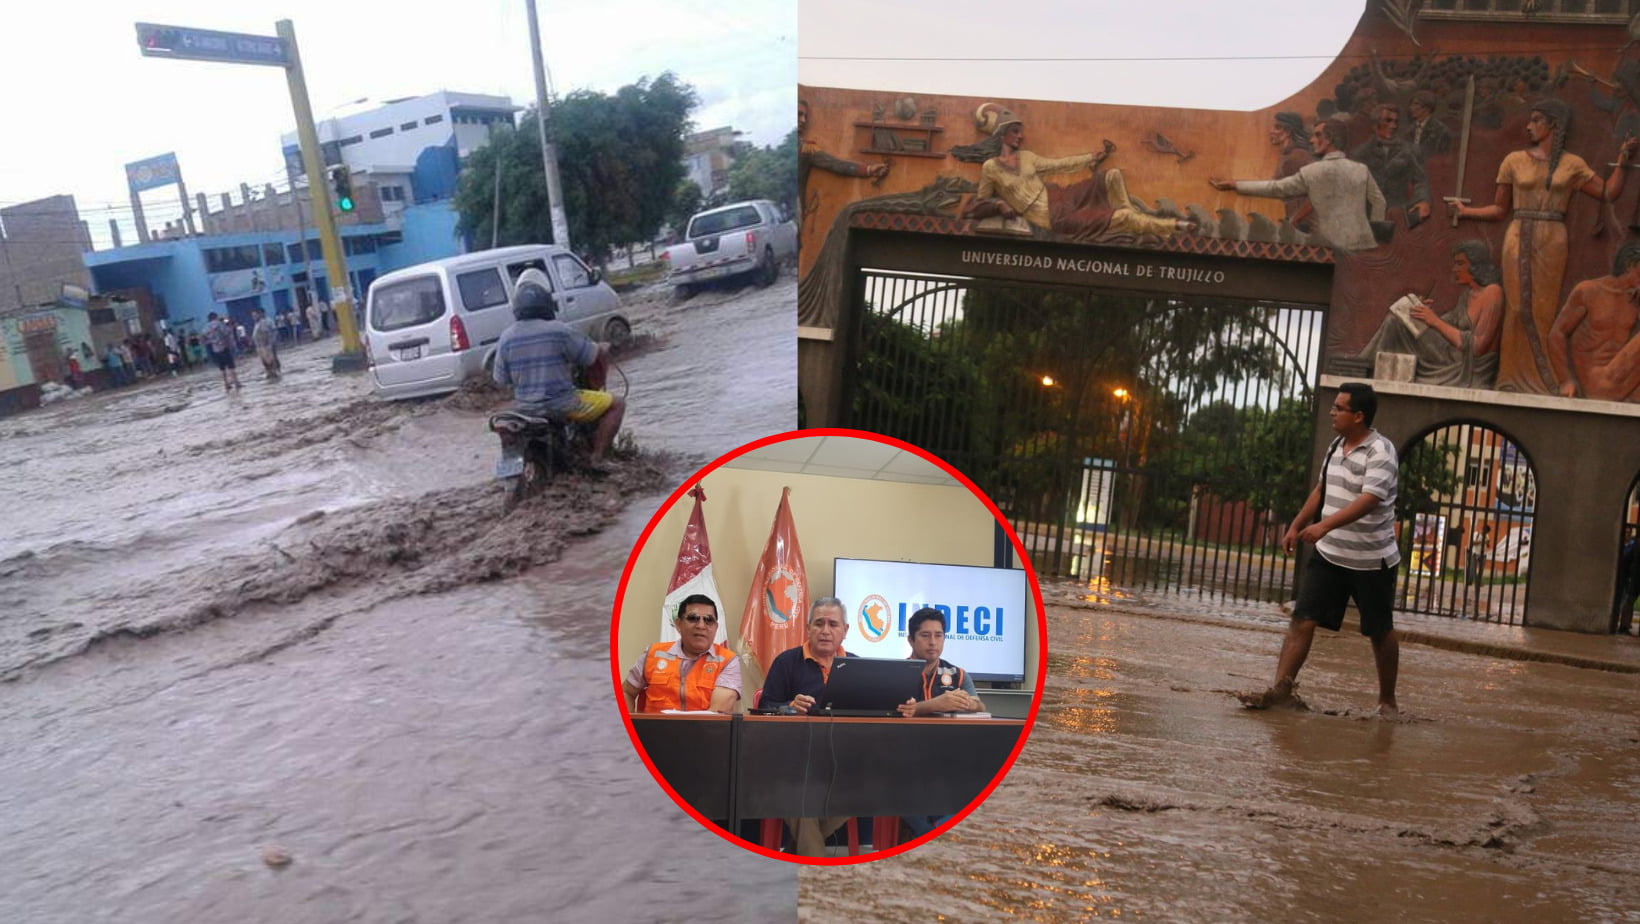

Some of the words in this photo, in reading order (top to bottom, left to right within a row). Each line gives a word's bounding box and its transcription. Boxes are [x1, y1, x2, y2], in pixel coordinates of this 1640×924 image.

[961, 250, 1053, 268] UNIVERSIDAD
[1056, 257, 1130, 276] NACIONAL
[1136, 265, 1153, 277] DE
[1159, 266, 1225, 283] TRUJILLO
[898, 602, 1004, 636] IDECI
